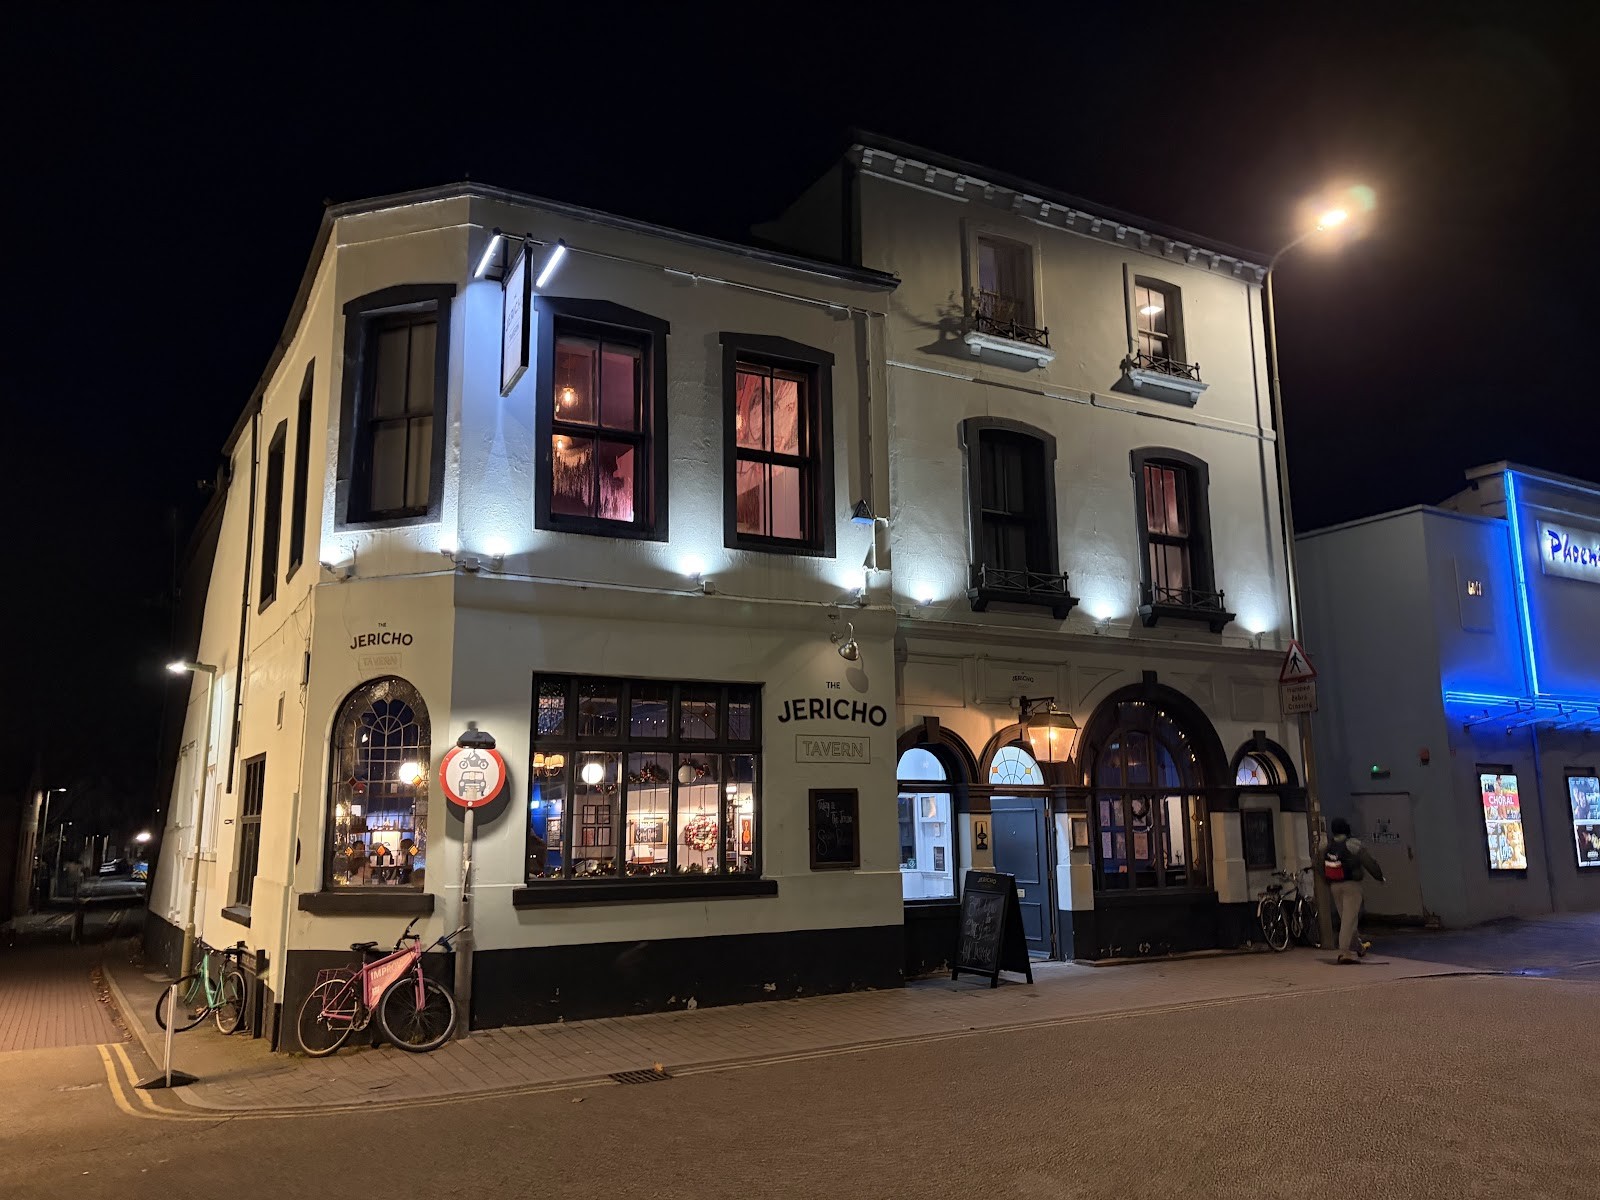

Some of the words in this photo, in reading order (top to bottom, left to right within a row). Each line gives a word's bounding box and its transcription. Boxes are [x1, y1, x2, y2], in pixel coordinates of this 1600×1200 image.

[1547, 529, 1600, 567] Phoen
[350, 632, 413, 650] JERICHO
[362, 656, 398, 666] TAVERN
[826, 681, 841, 690] THE
[777, 698, 887, 727] JERICHO
[802, 741, 864, 758] TAVERN
[1488, 796, 1514, 805] CHORAL
